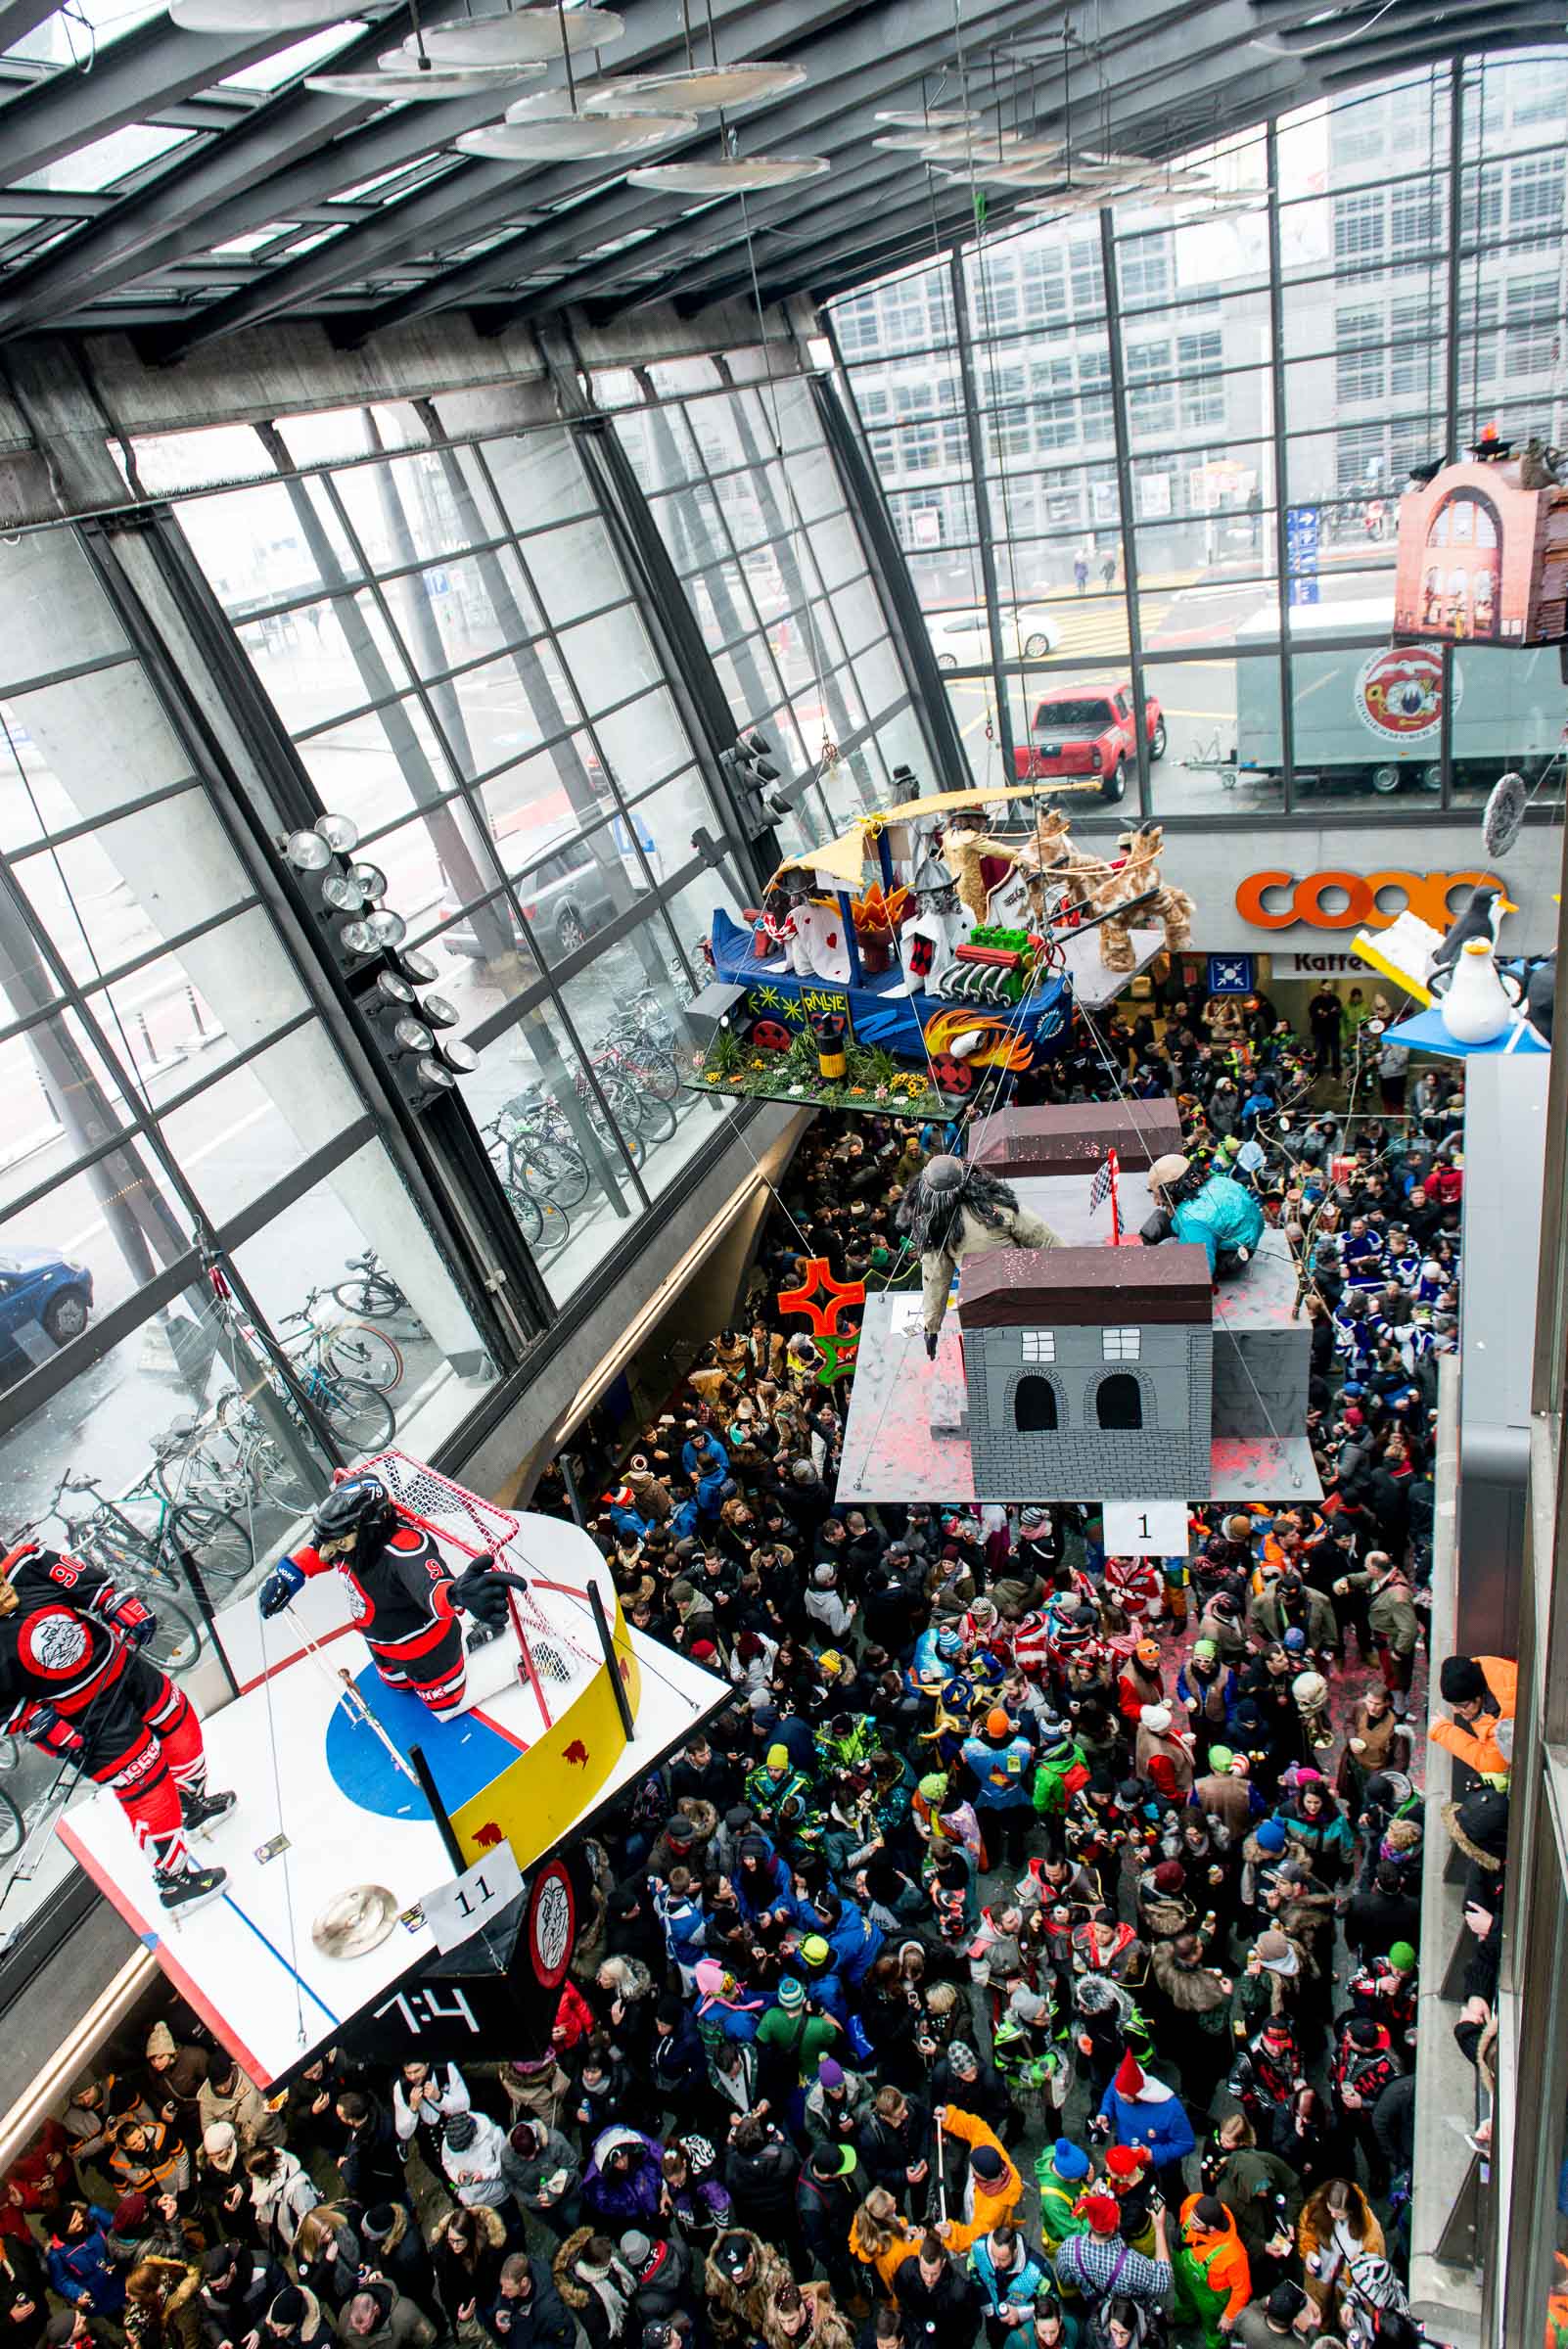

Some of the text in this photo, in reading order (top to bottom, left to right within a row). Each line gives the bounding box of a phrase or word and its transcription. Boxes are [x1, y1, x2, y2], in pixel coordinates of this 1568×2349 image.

[1236, 870, 1508, 936] coop
[804, 991, 847, 1012] RALLYE
[367, 1485, 383, 1501] 79
[1138, 1514, 1152, 1540] 1
[119, 1742, 161, 1786] 1959
[454, 1875, 495, 1918] 11
